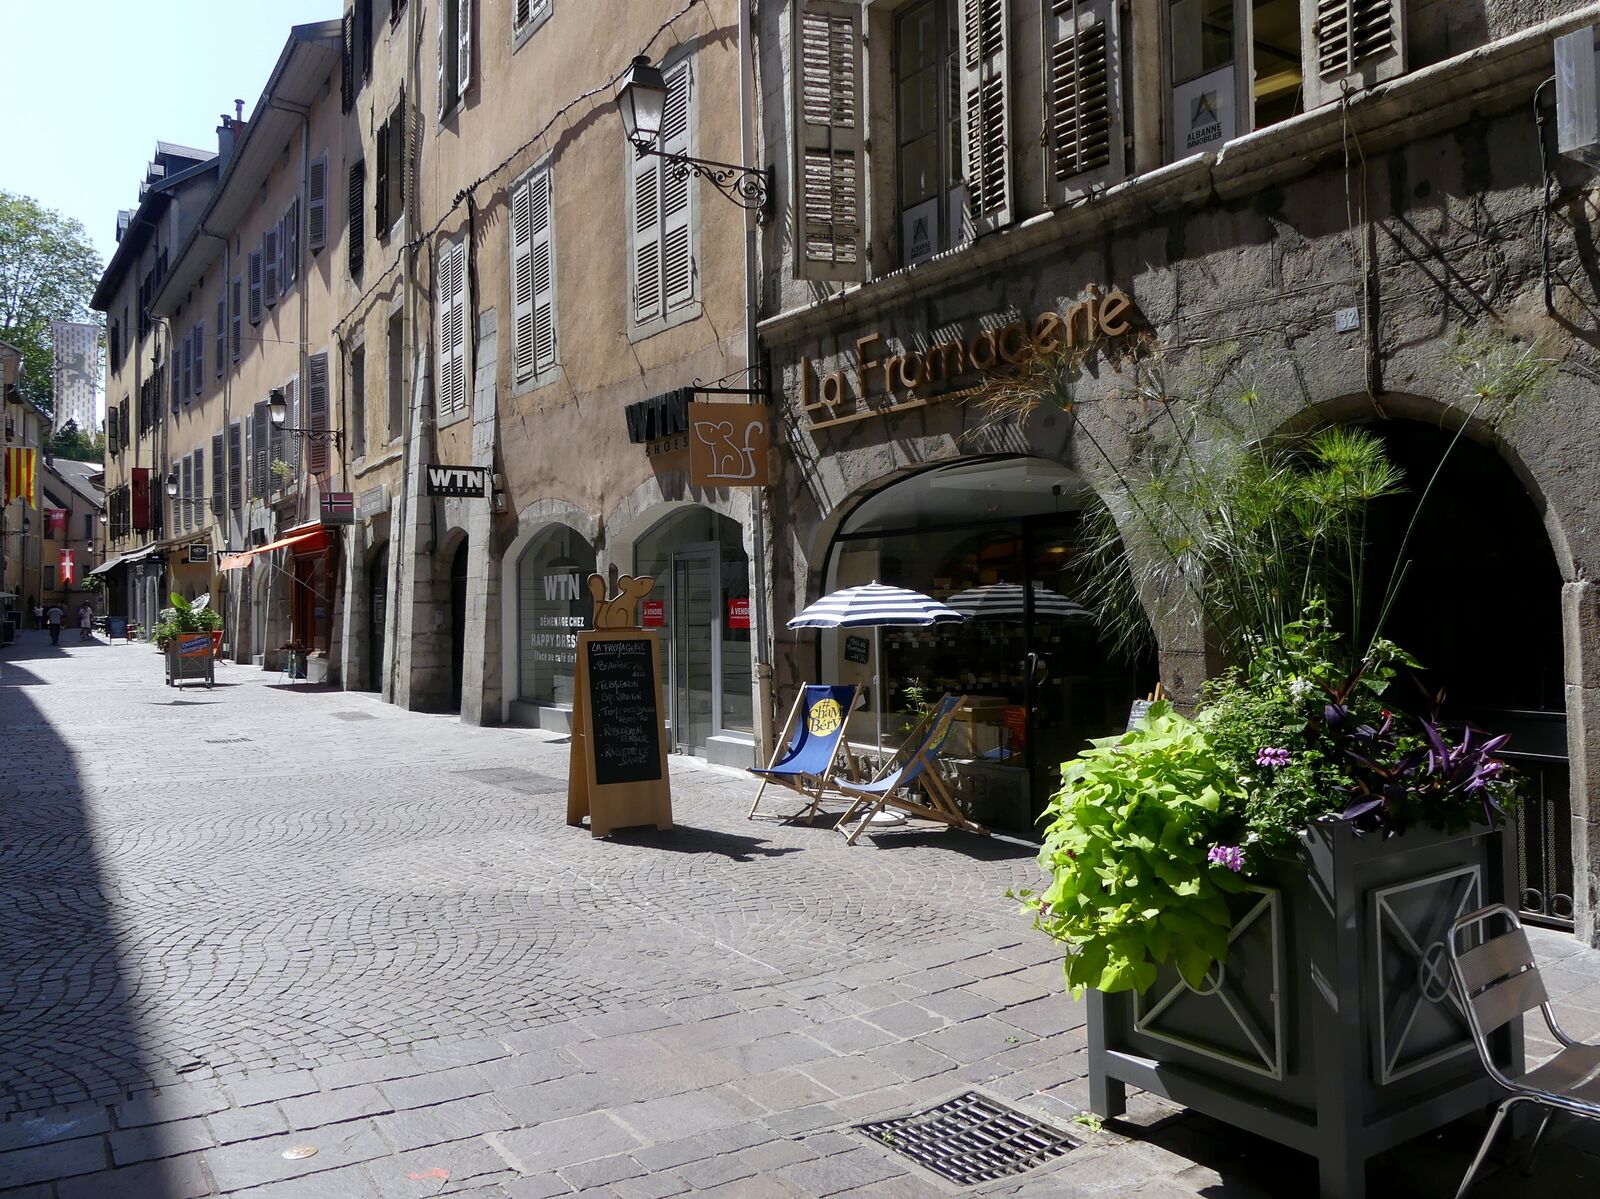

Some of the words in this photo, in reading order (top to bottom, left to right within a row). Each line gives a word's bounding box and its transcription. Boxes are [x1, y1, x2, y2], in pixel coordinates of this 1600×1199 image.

[1187, 122, 1222, 142] ALBANNE
[1187, 131, 1223, 149] IMMOBILIER
[1338, 310, 1357, 329] 32
[801, 355, 845, 411] La
[857, 283, 1133, 400] Fromagerie
[646, 436, 688, 457] SHOES
[428, 469, 483, 488] WTN
[543, 573, 580, 601] WTN
[569, 616, 585, 627] CHEZ
[531, 633, 555, 647] HAPPY
[556, 634, 578, 649] DRES
